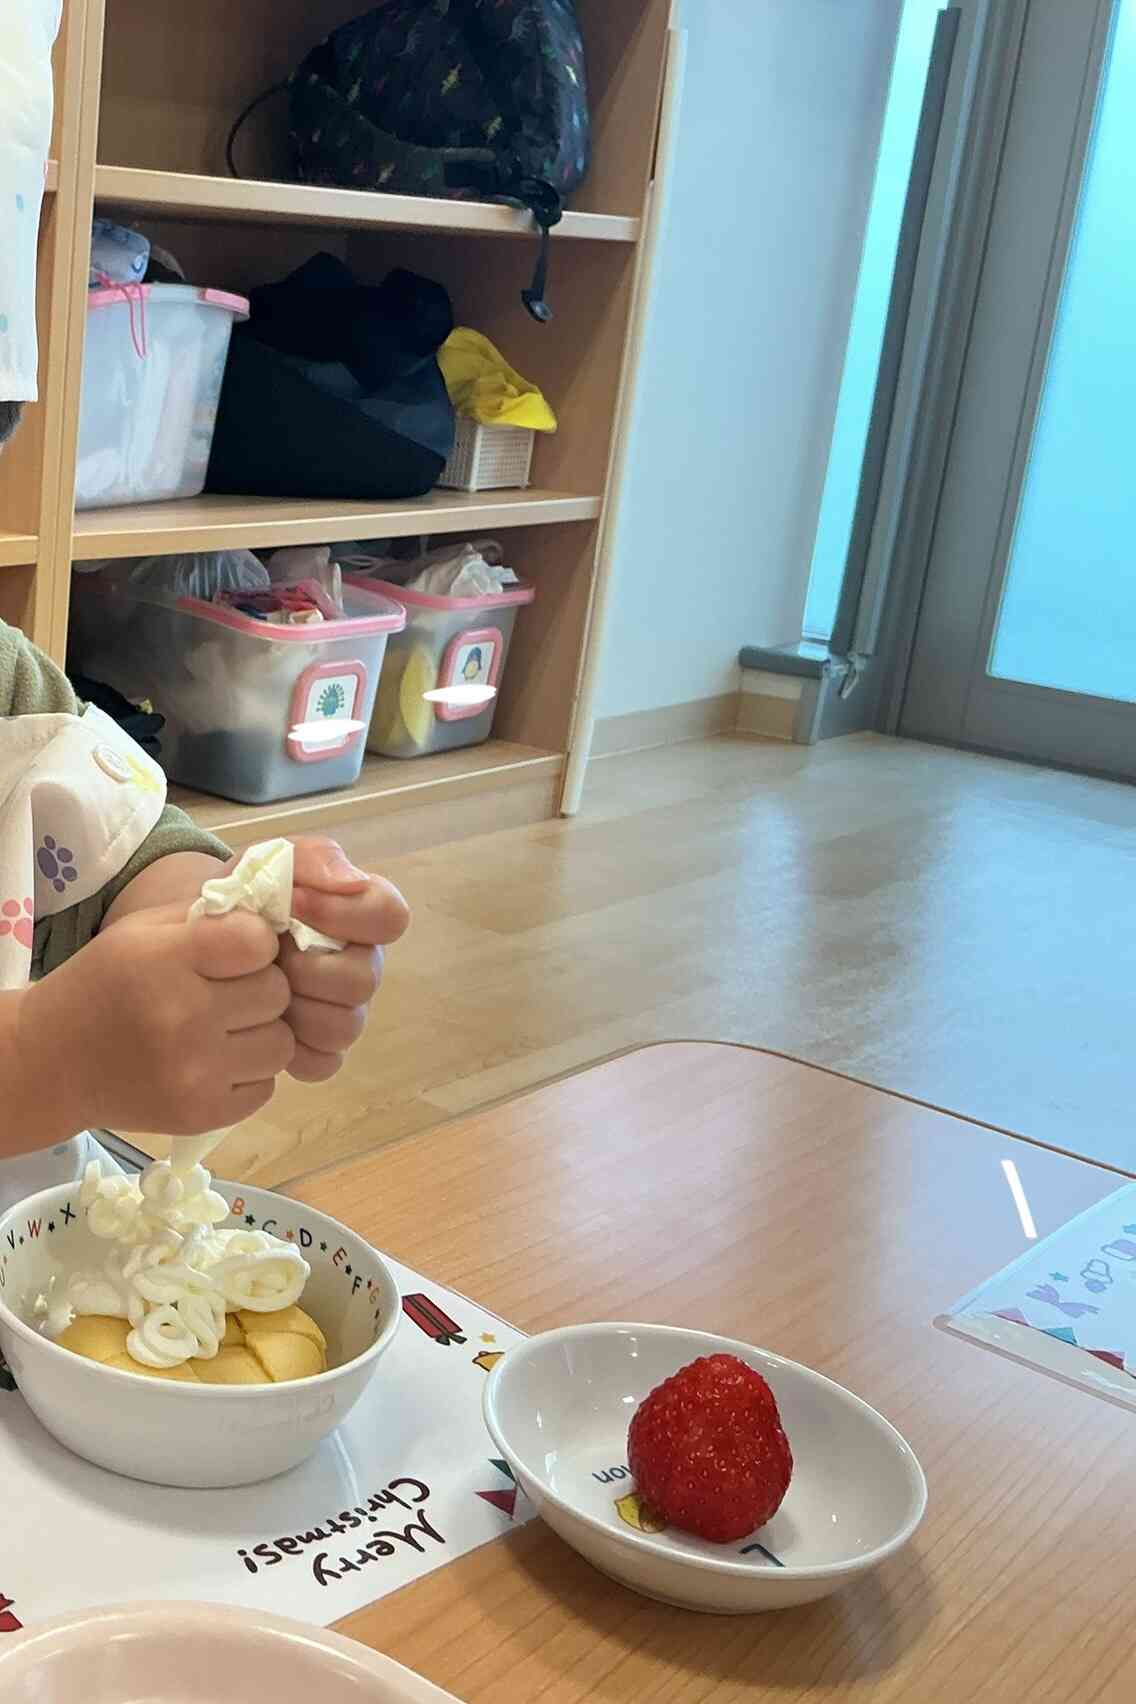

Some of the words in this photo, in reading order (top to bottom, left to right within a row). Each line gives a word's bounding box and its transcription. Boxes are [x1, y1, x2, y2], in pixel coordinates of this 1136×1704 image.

[6, 1229, 15, 1250] V
[27, 1218, 42, 1238] W
[59, 1202, 76, 1225] X
[231, 1197, 245, 1216] B
[299, 1228, 313, 1248] D
[332, 1247, 348, 1267] E
[351, 1275, 363, 1296] F
[237, 1477, 431, 1574] Christmas!
[313, 1508, 446, 1587] Merry
